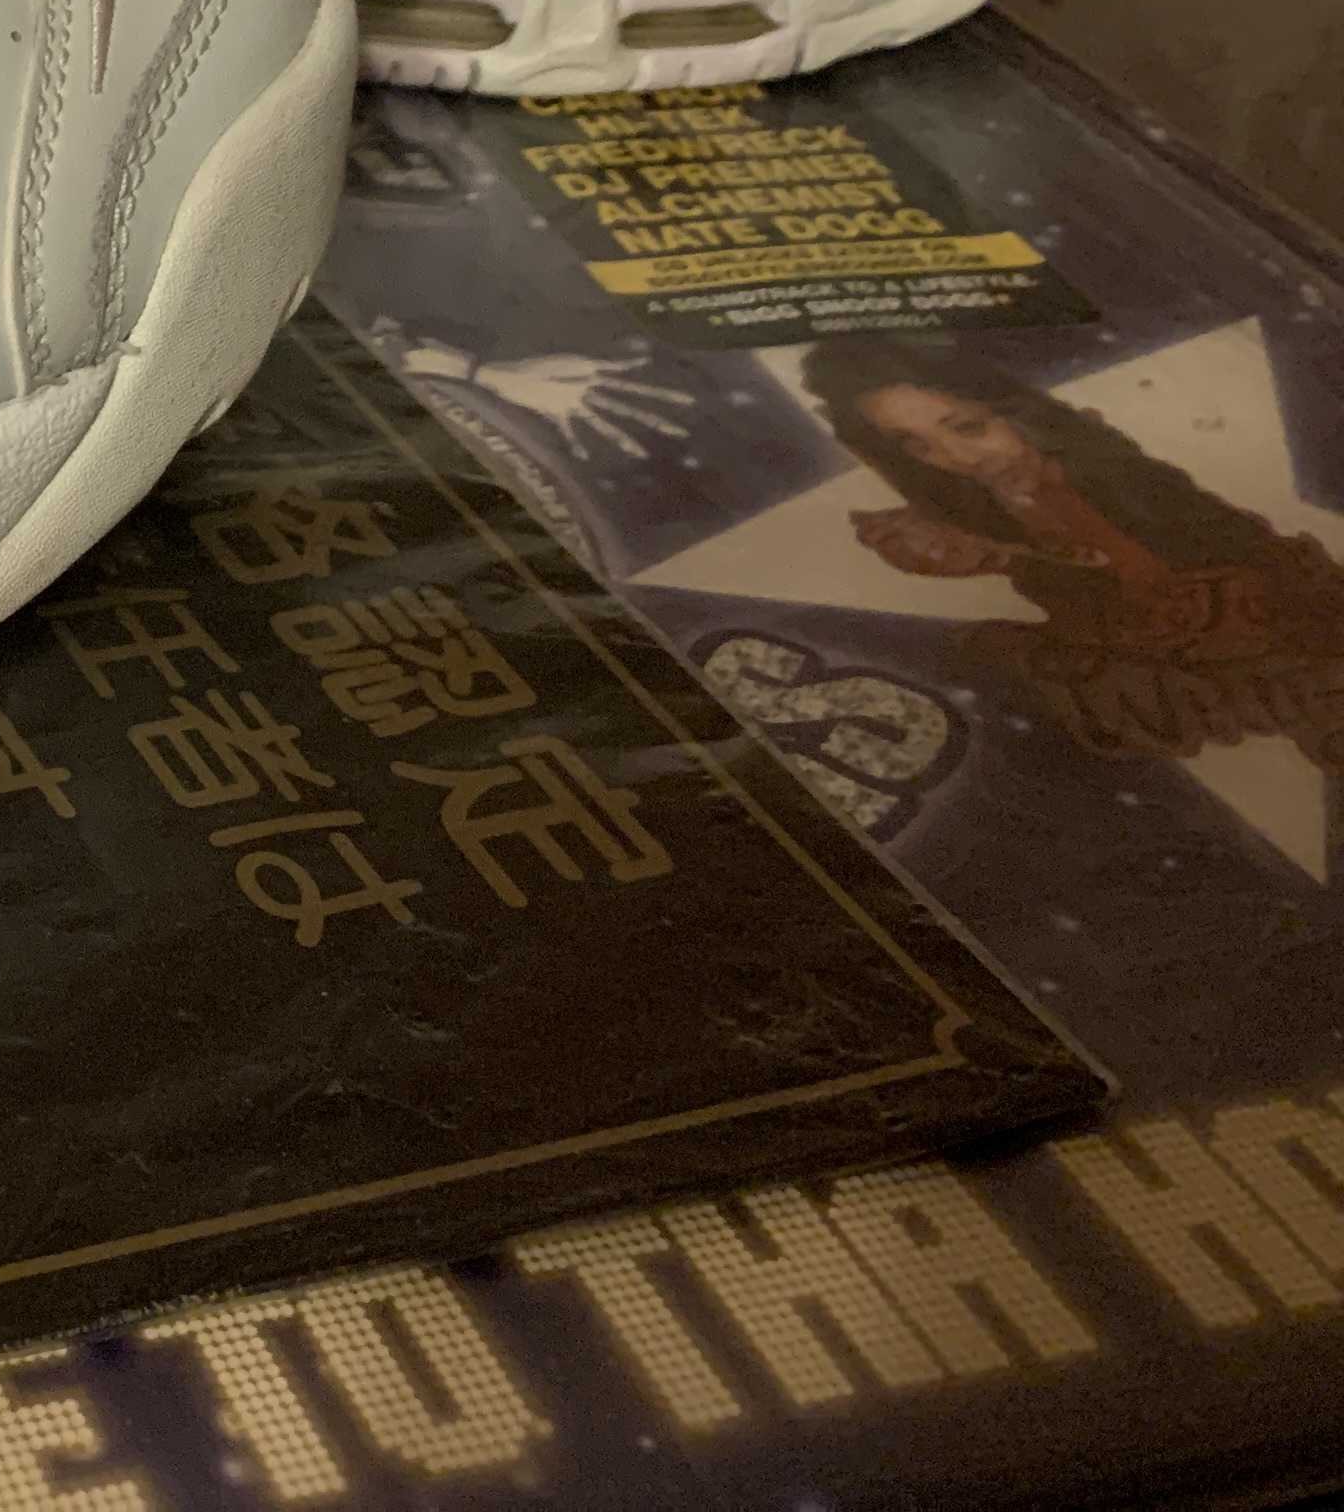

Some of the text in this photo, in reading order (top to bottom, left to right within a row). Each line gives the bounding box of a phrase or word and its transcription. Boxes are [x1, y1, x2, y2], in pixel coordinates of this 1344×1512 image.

[552, 153, 891, 199] DJ PREMIER
[593, 180, 903, 225] ALCHEMIST
[611, 207, 946, 255] NATE DOGG
[144, 1265, 552, 1498] TO
[514, 1159, 1102, 1430] THA
